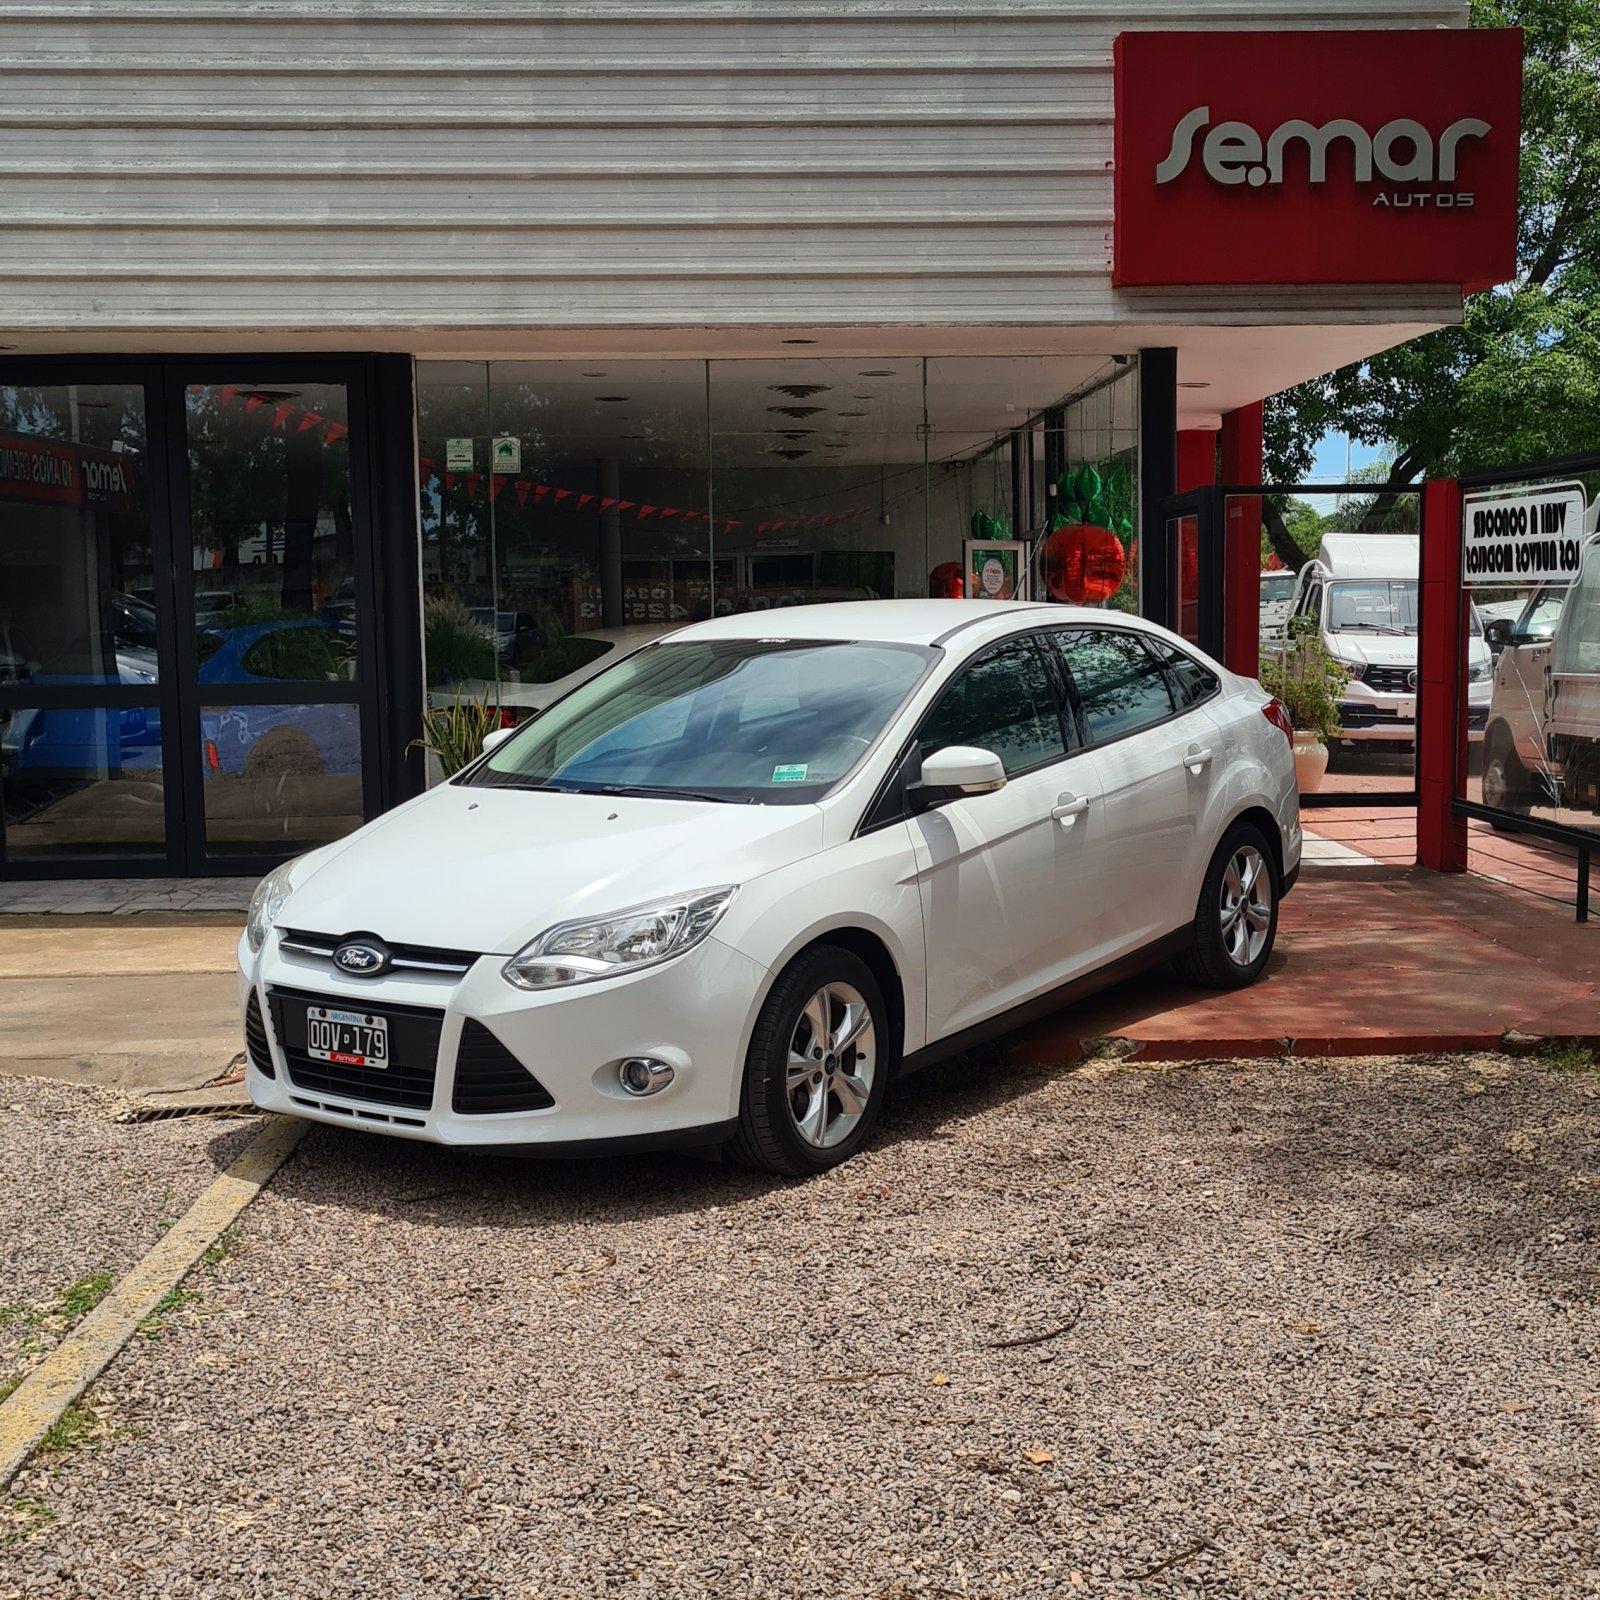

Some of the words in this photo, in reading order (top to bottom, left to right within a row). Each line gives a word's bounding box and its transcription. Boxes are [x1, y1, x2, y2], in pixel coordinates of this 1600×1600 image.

[1373, 192, 1474, 208] AUTOS
[341, 949, 370, 967] Ford
[330, 1012, 363, 1024] ARGENTINA
[352, 1026, 385, 1058] 179
